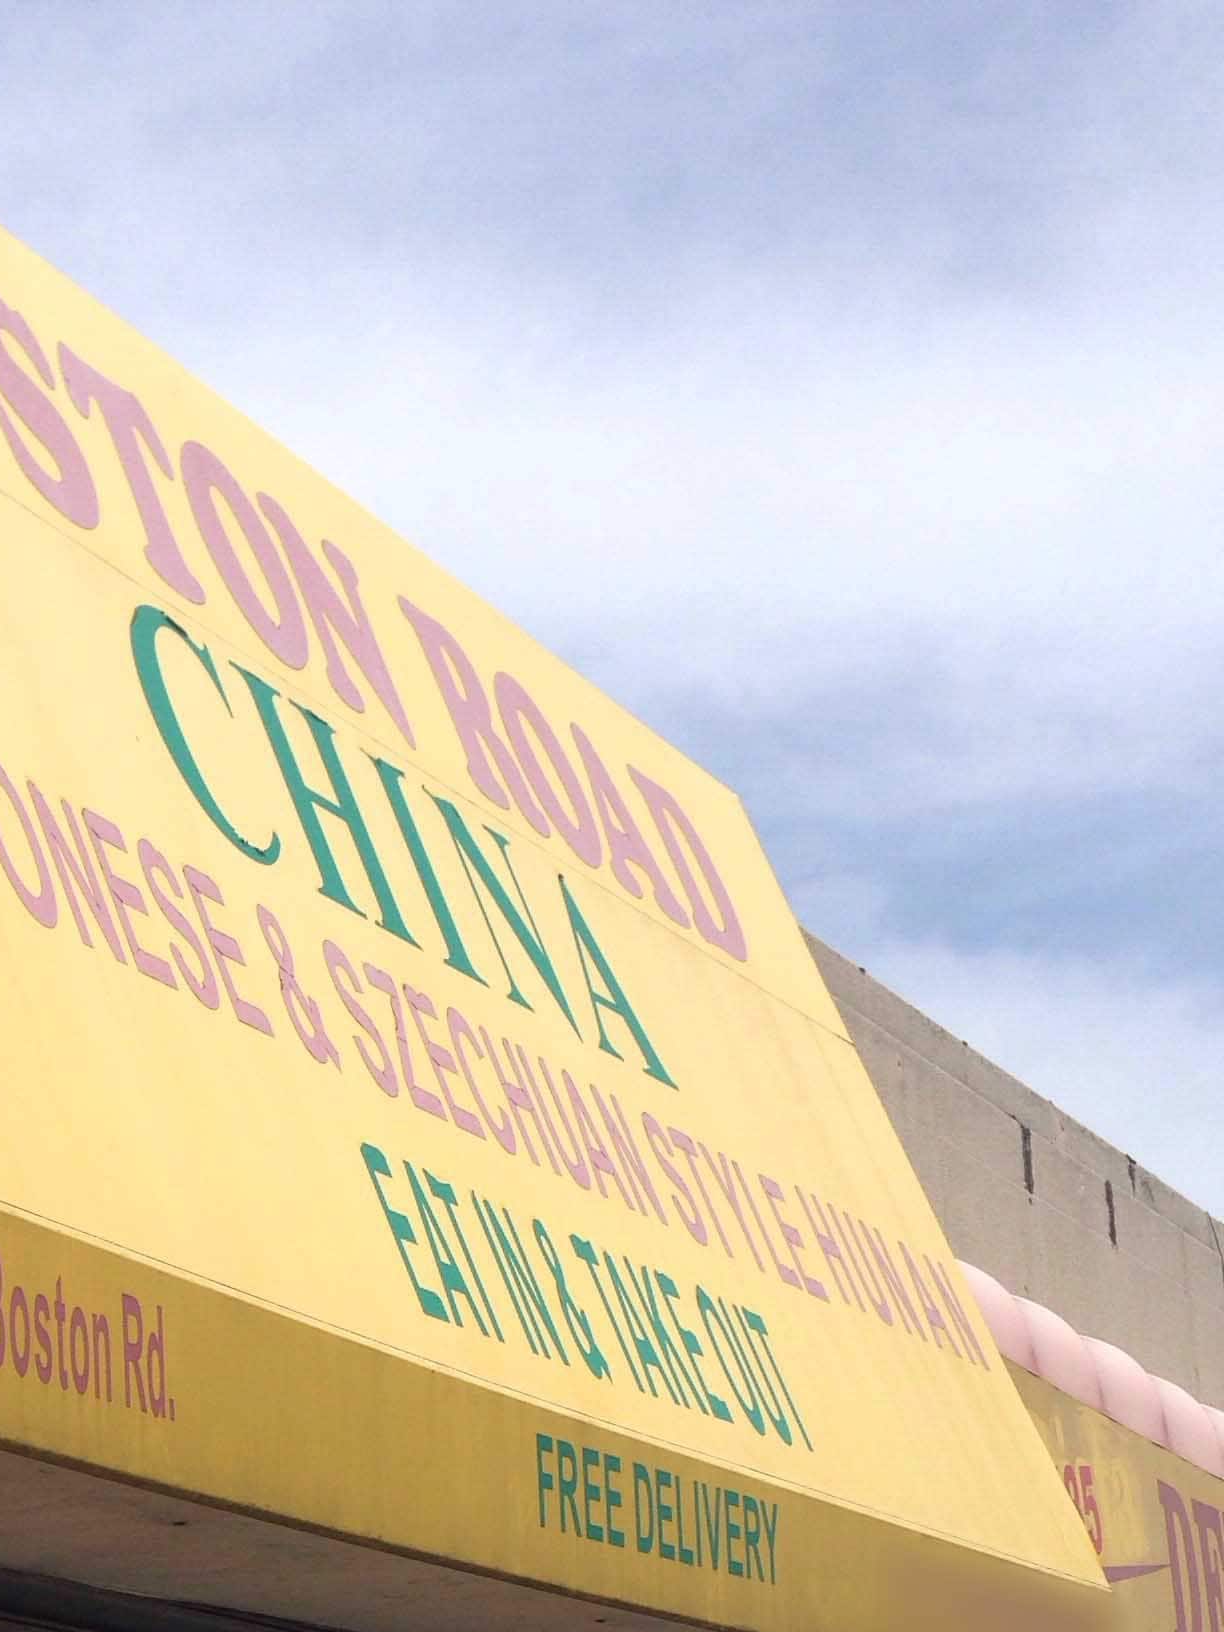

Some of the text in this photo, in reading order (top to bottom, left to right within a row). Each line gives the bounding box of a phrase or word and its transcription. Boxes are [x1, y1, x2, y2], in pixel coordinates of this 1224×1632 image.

[129, 604, 680, 1091] CHINA
[397, 594, 748, 963] ROAD
[256, 903, 342, 1074] &
[322, 939, 669, 1227] SZECHUAN
[642, 1111, 831, 1304] STYLE
[795, 1184, 991, 1372] HUNAN
[360, 1142, 814, 1453] EAT IN & TAKE OUT
[121, 1292, 176, 1422] Rd.
[535, 1432, 779, 1586] FREE DELIVERY
